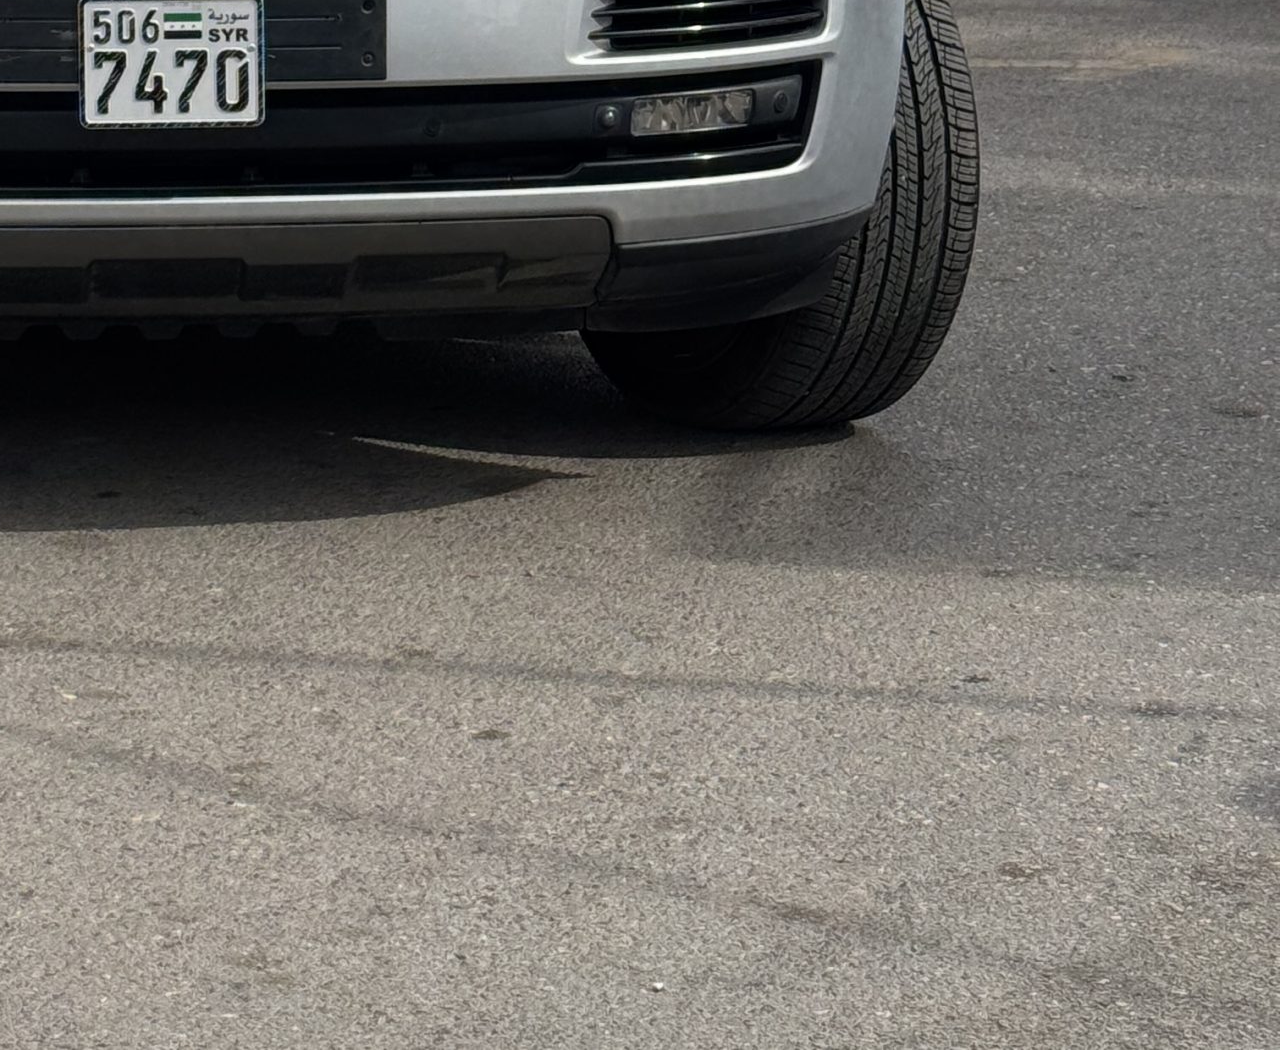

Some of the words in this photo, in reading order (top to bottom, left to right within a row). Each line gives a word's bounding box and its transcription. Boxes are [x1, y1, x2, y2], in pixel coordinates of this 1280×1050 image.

[93, 9, 160, 45] 506
[208, 8, 250, 25] سورية
[208, 28, 249, 42] SYR
[94, 49, 250, 115] 7470
